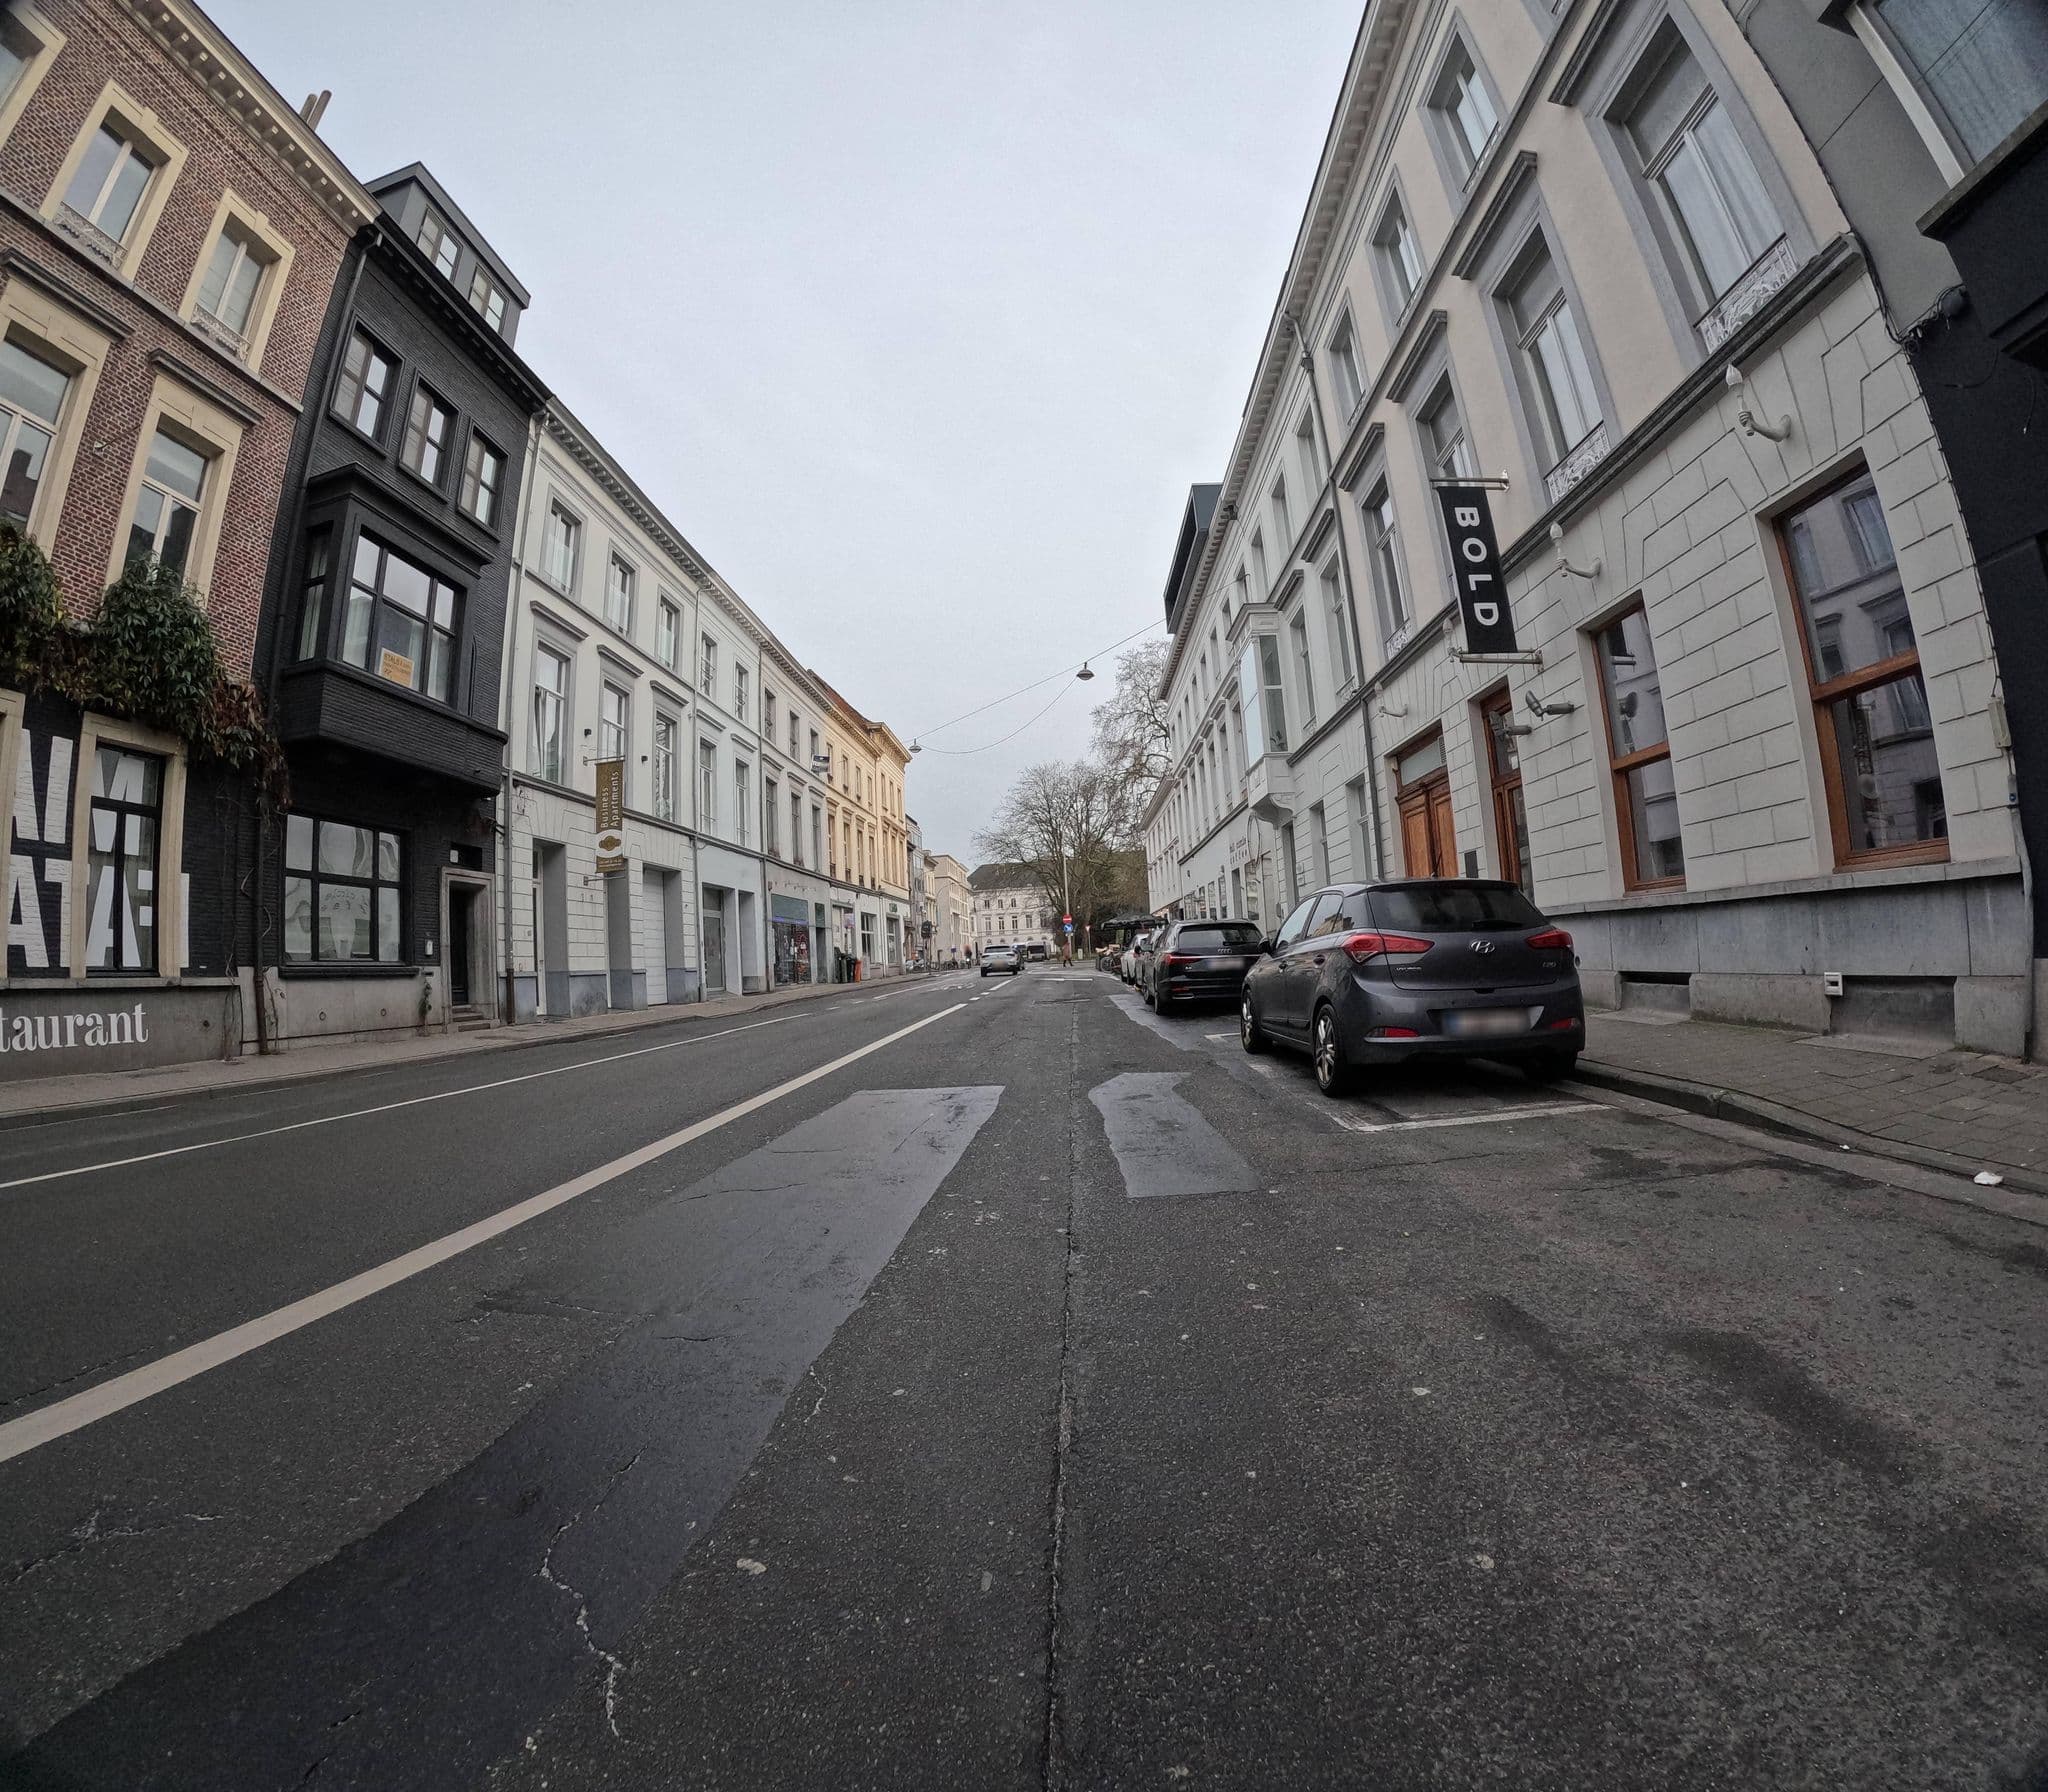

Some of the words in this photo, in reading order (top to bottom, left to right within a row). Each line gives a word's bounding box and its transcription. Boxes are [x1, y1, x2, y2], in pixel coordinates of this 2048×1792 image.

[1454, 506, 1500, 627] BOLD
[600, 786, 609, 829] Business
[610, 770, 620, 828] Apartments
